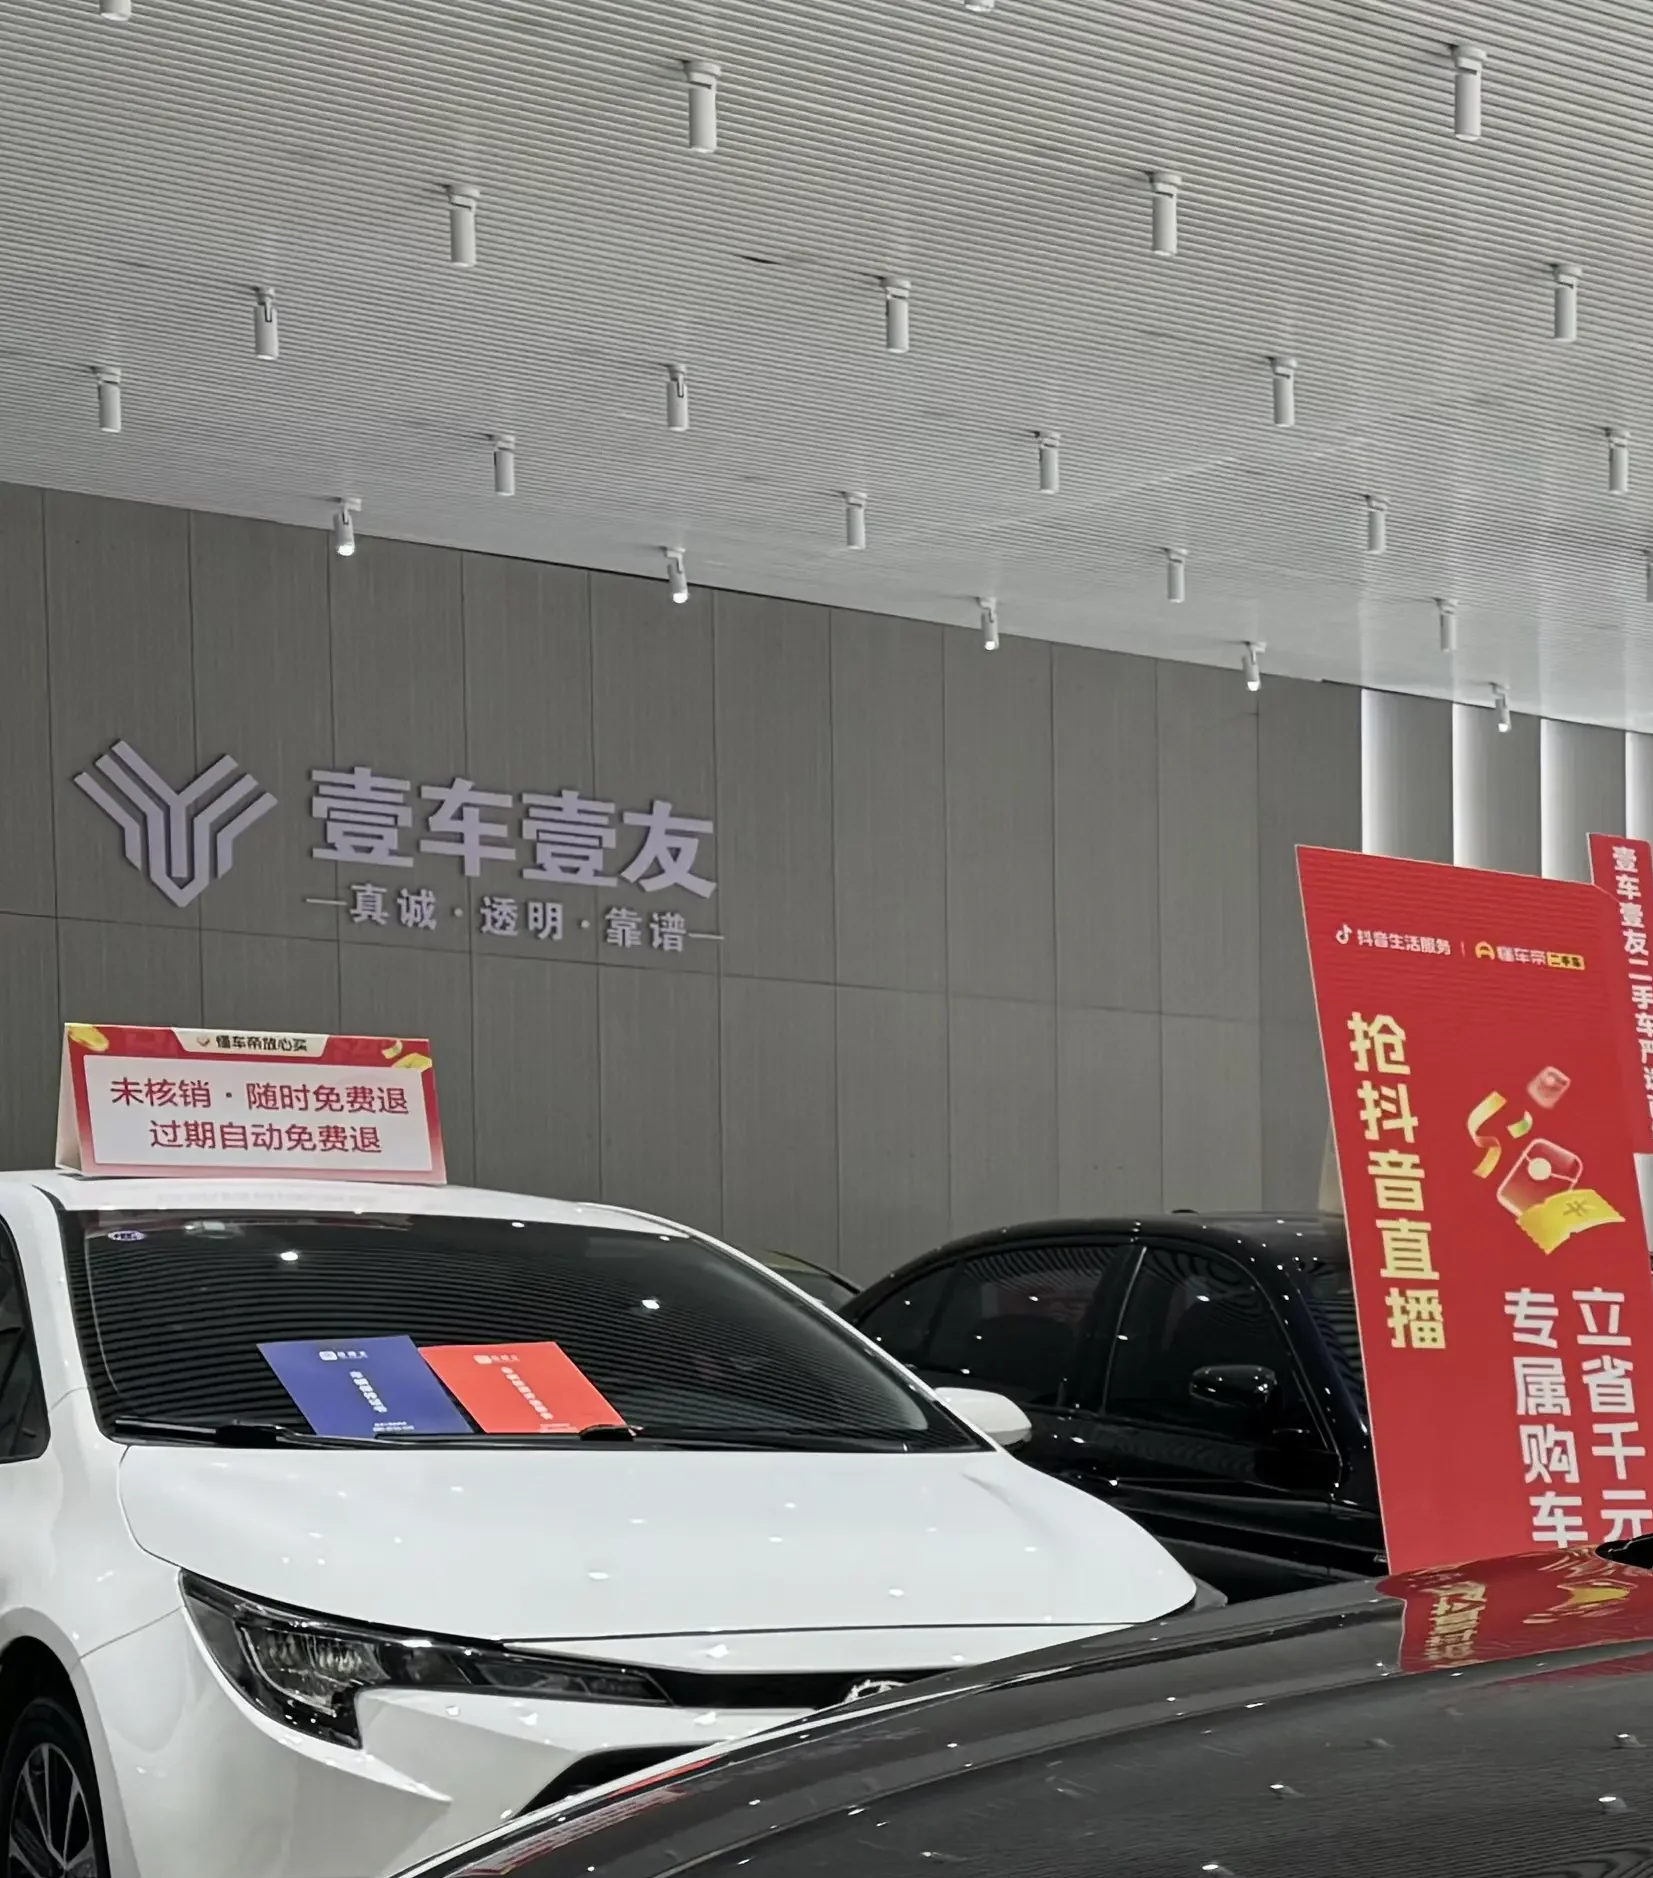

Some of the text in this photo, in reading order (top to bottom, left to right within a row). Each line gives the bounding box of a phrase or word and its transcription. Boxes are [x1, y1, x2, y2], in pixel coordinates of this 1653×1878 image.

[312, 766, 716, 899] 壹车壹友
[1357, 929, 1451, 955] 抖音生活服务
[149, 1120, 382, 1153] 过期自动免费退
[1347, 1011, 1446, 1349] 抢抖音直播
[1504, 1287, 1588, 1549] 专属购车
[1572, 1286, 1653, 1544] 立省千元
